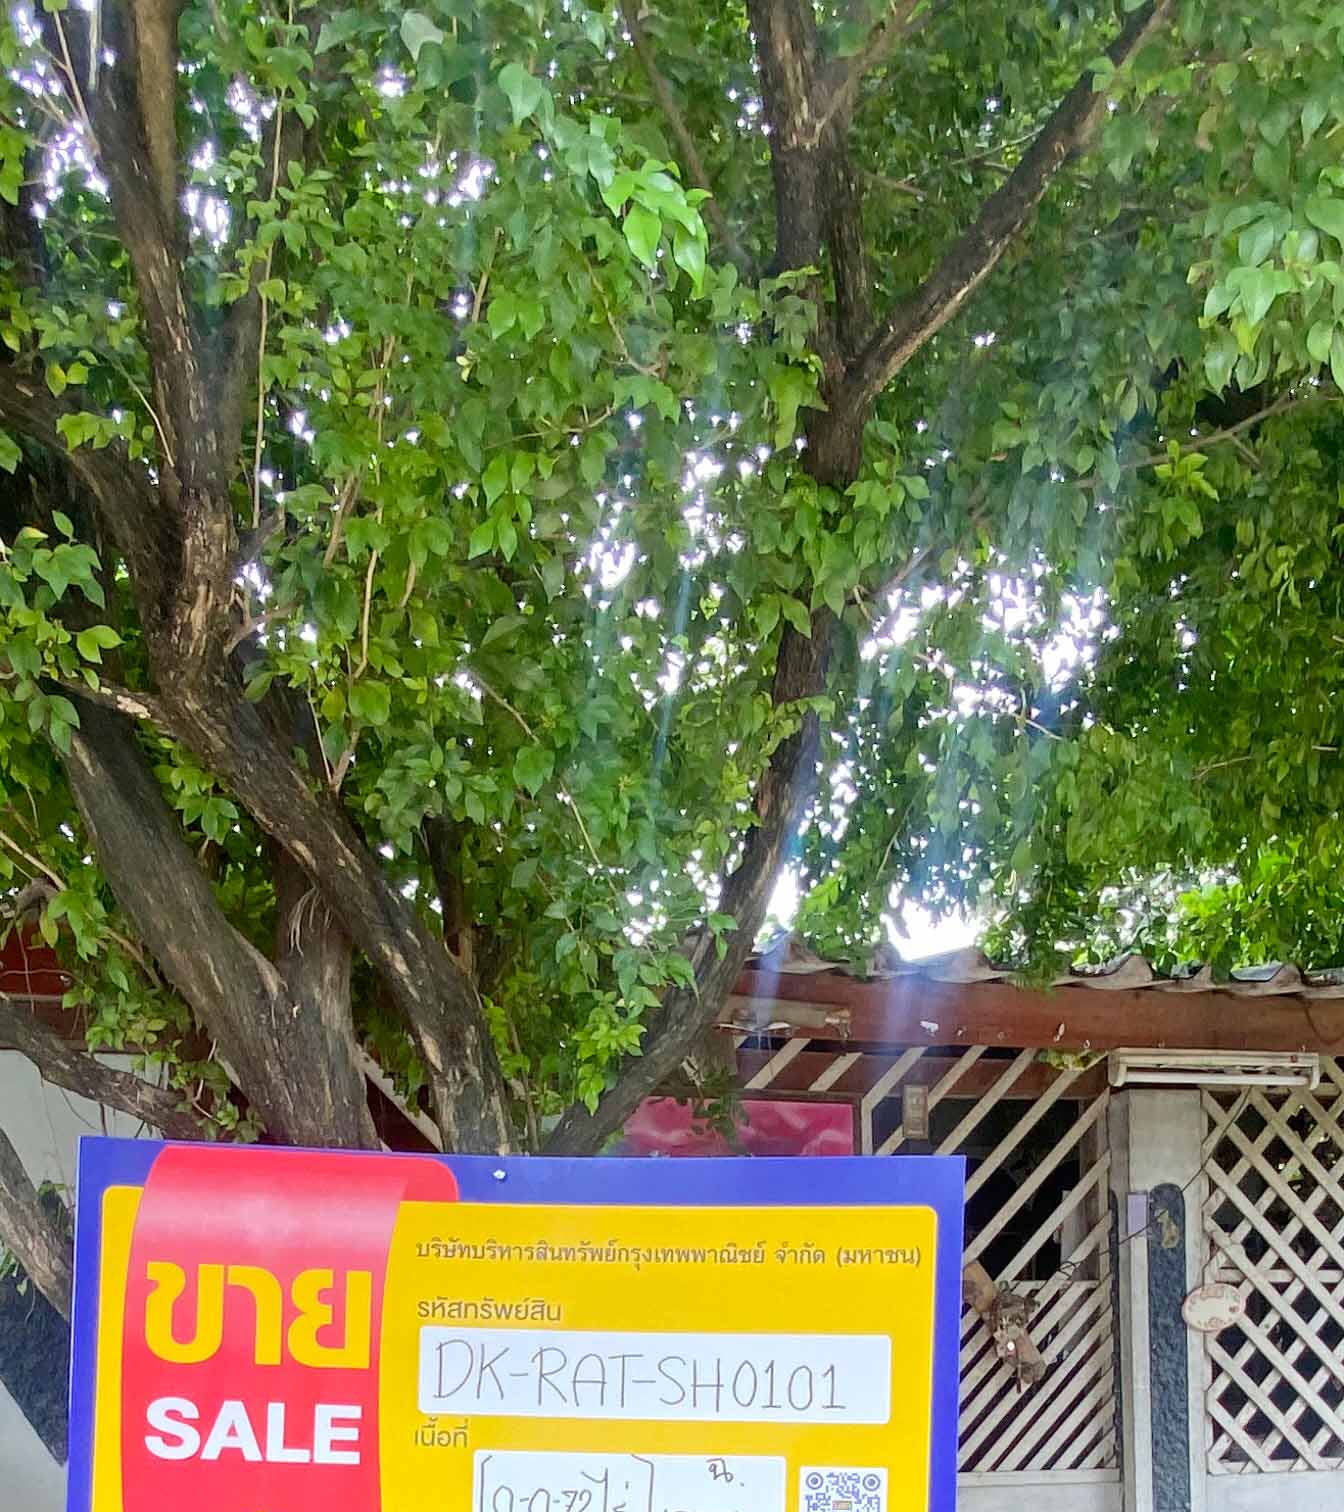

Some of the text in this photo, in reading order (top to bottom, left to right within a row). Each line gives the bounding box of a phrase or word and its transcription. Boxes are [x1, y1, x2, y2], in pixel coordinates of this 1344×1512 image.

[415, 1237, 922, 1271] บริษัทบริหารสินทรัพย์กรุงเทพพาณิชย์ จำกัด (มหาชน)
[144, 1260, 372, 1370] ขาย
[416, 1296, 562, 1323] รหัสทรัพย์สิน
[433, 1339, 847, 1413] DK-RAT-SH0101
[143, 1396, 363, 1465] SALE
[414, 1416, 469, 1449] เนื้อที่
